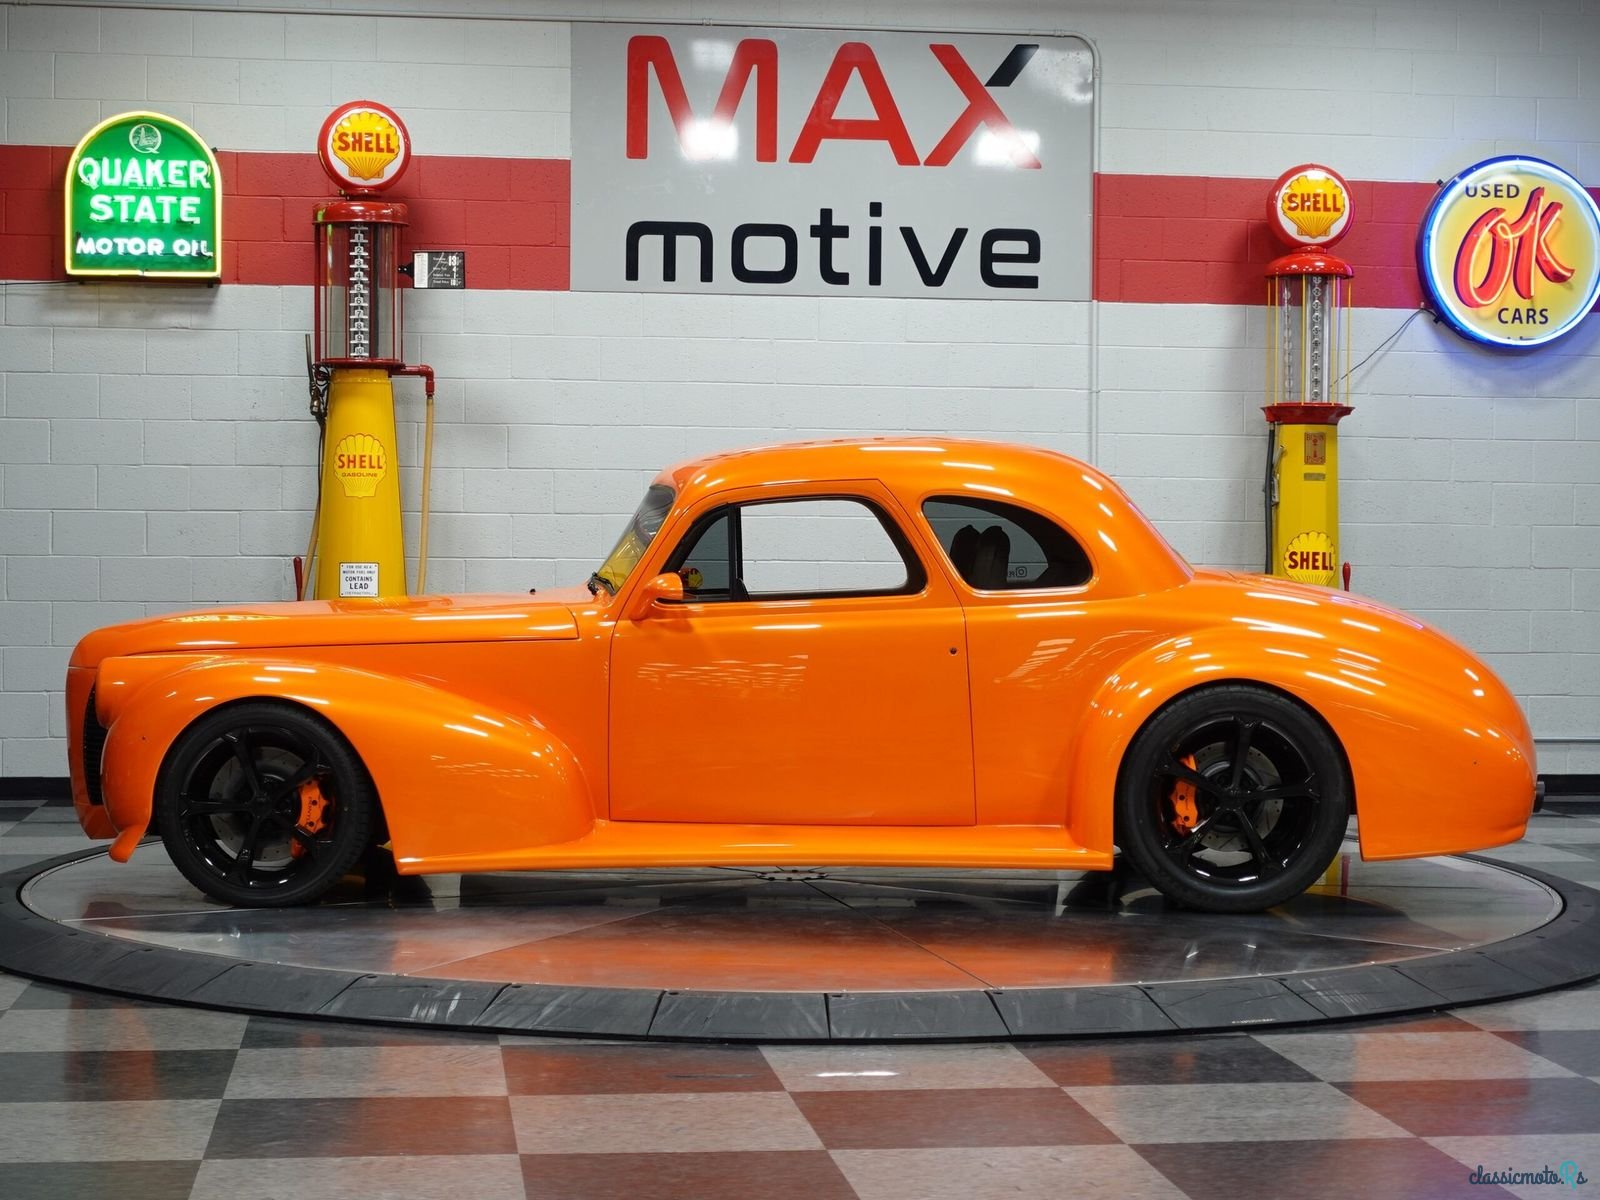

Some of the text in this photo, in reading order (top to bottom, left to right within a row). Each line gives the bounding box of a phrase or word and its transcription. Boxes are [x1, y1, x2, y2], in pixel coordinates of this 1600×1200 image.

[626, 35, 1042, 169] MAX
[338, 132, 395, 153] SHELL
[78, 157, 211, 189] QUAKER
[1465, 183, 1520, 199] USED
[89, 194, 200, 224] STATE
[1287, 193, 1341, 212] SHELL
[76, 237, 213, 257] MOTOR OIL
[626, 201, 1041, 289] motive
[1452, 186, 1575, 308] OK
[1497, 308, 1549, 324] CARS
[338, 454, 383, 469] SHELL
[1288, 551, 1334, 571] SHELL
